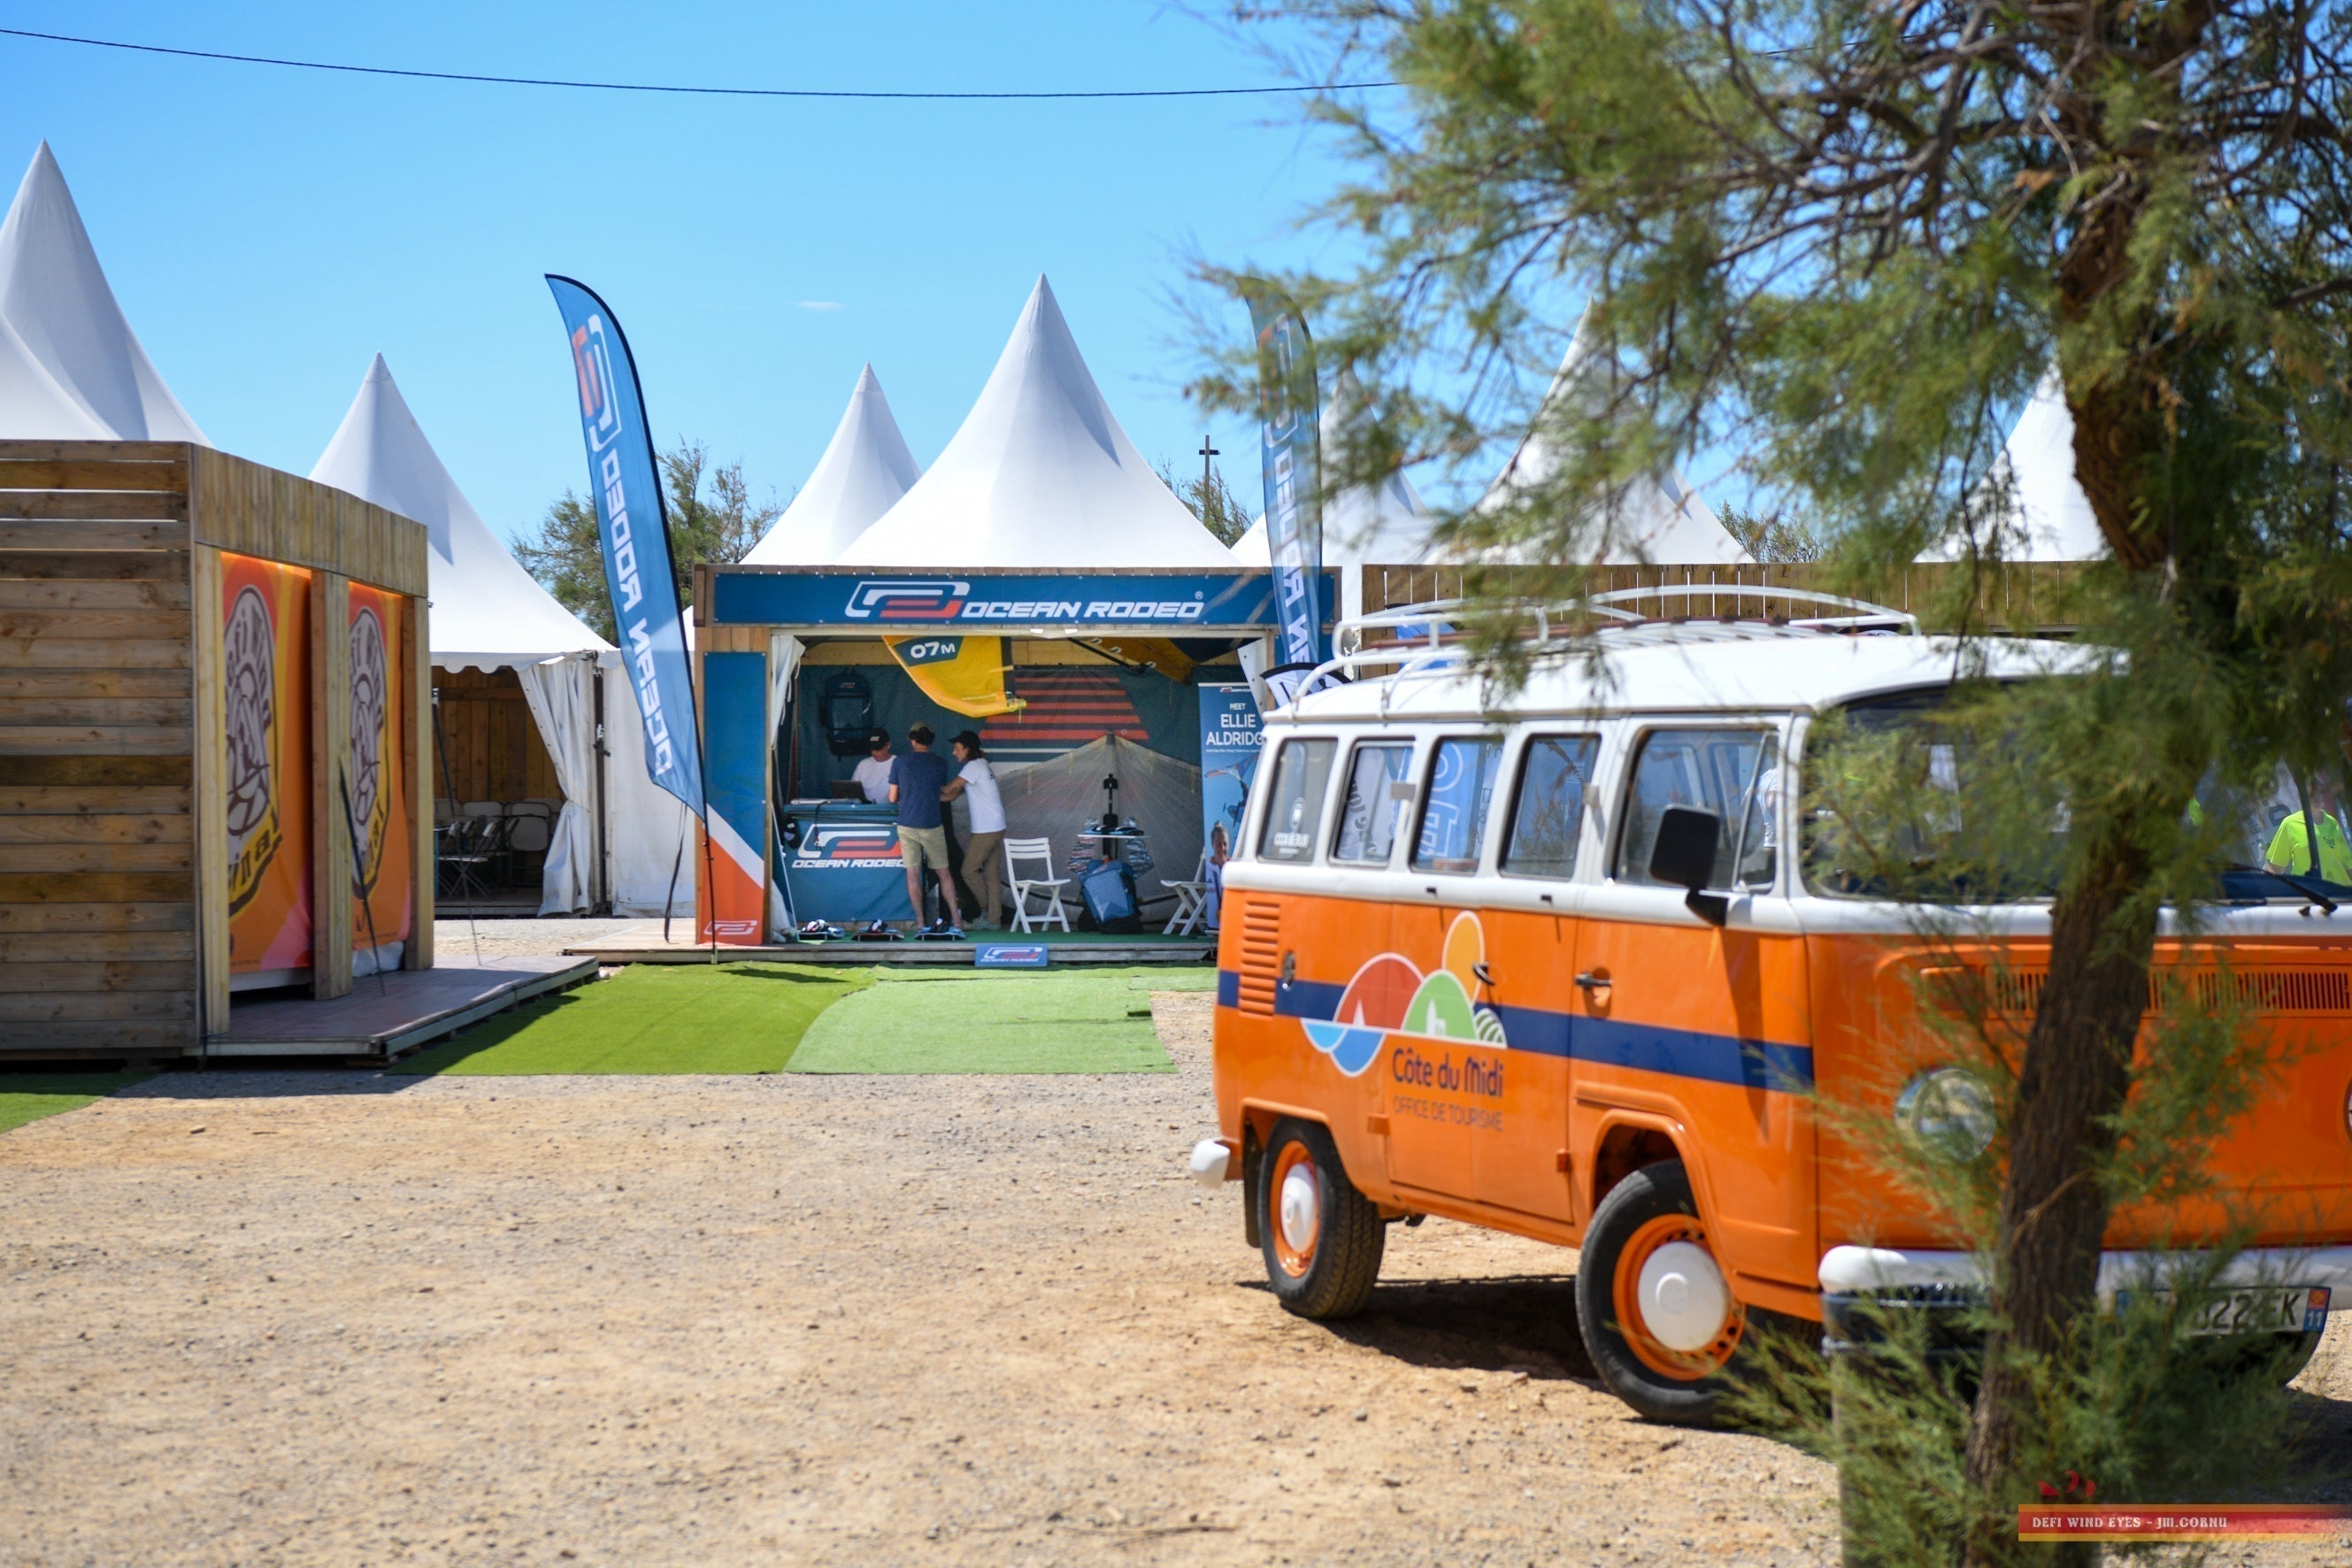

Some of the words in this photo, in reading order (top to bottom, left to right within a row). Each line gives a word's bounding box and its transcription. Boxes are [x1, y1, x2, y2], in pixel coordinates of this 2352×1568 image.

[961, 602, 1081, 618] OCEAN
[1083, 602, 1204, 618] RODEO
[911, 642, 956, 658] 07M
[1220, 714, 1257, 728] ELLIE
[1206, 731, 1264, 746] ALDRIDG
[792, 859, 849, 868] OCEAN
[1393, 1047, 1433, 1087] Côte
[1437, 1053, 1459, 1090] du
[1464, 1057, 1503, 1098] Midi
[1393, 1095, 1429, 1118] OFFICE
[1431, 1101, 1445, 1122] DE
[1448, 1103, 1503, 1132] TOURISME
[2307, 1310, 2325, 1328] 11
